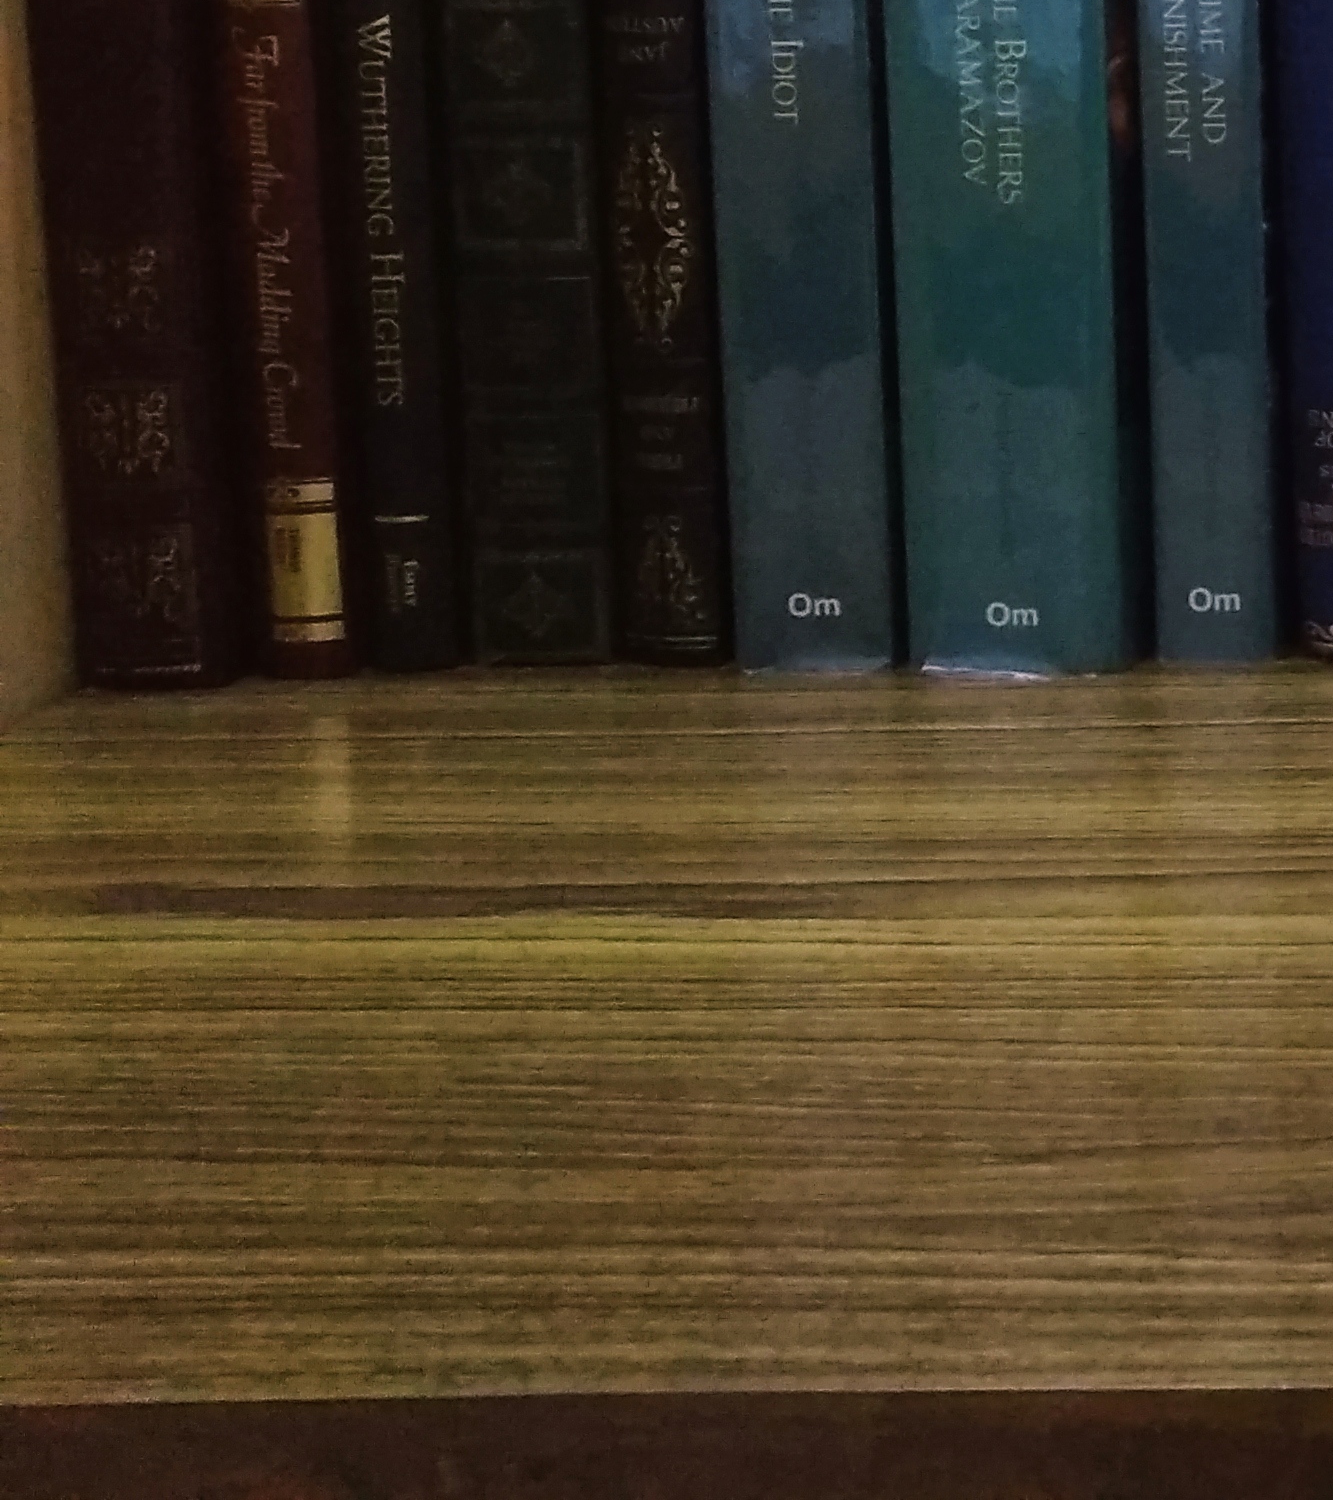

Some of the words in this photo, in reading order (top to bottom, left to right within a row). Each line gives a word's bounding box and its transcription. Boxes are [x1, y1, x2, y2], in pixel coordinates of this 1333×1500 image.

[768, 39, 805, 125] IDIOT
[993, 38, 1028, 203] BROTHERS
[1201, 74, 1228, 143] AND
[356, 15, 396, 237] WUTHERING
[369, 251, 406, 406] HEIGHTS
[786, 592, 842, 616] Om
[987, 602, 1040, 626] Om
[1188, 588, 1241, 610] Om
